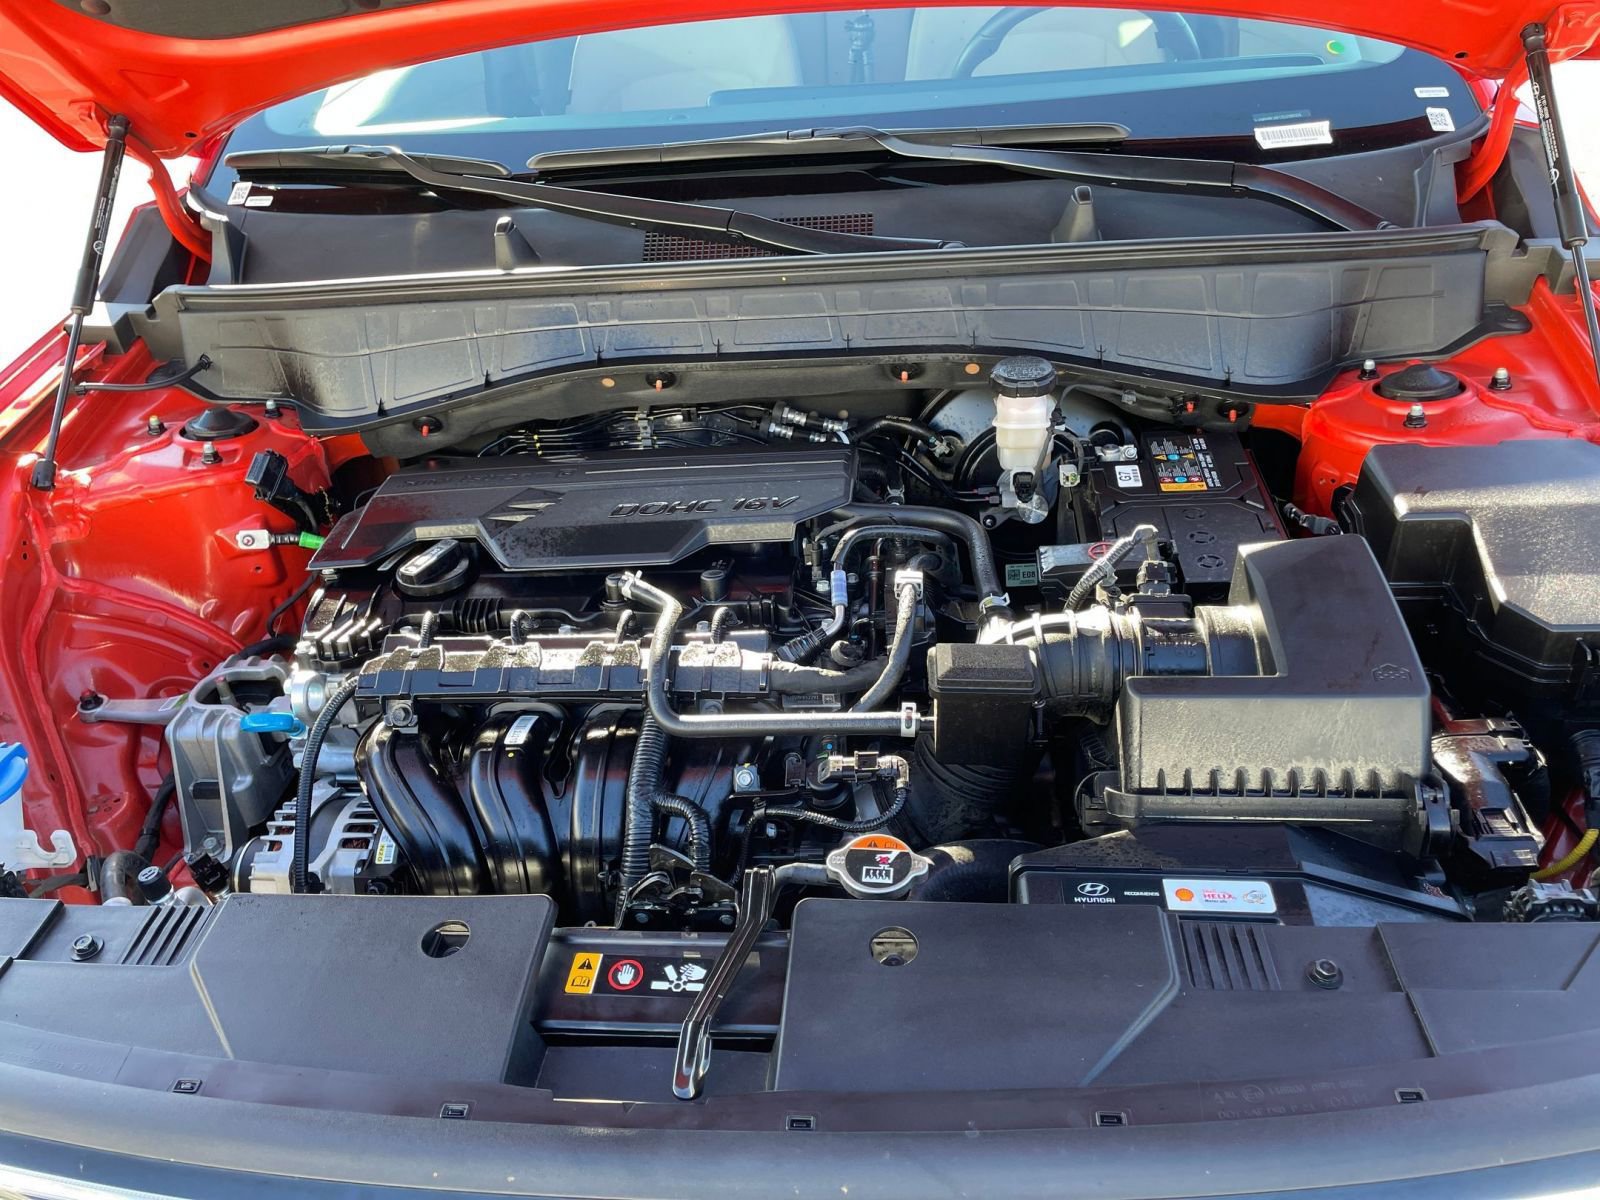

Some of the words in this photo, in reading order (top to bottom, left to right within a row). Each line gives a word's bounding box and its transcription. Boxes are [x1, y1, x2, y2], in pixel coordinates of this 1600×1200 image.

[1118, 471, 1132, 482] G7
[608, 498, 724, 518] DOHC
[732, 495, 801, 512] 16V
